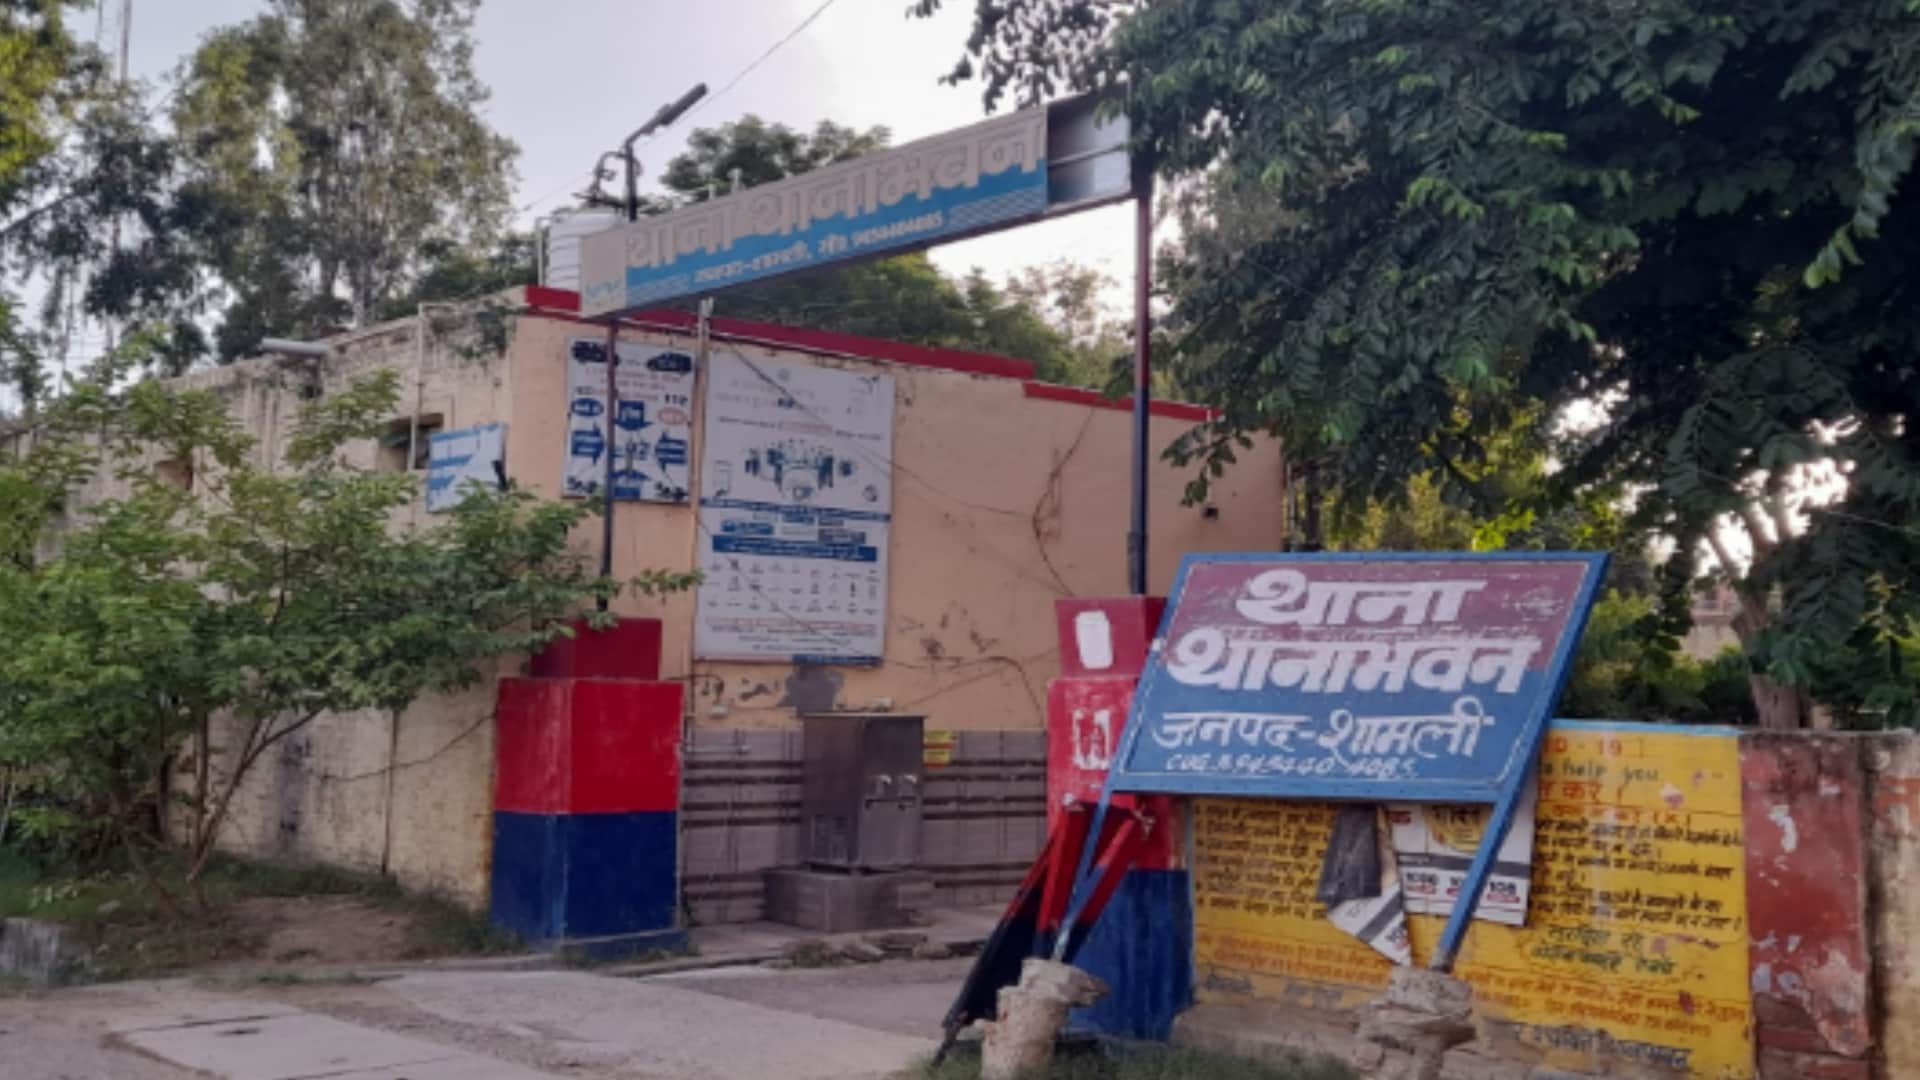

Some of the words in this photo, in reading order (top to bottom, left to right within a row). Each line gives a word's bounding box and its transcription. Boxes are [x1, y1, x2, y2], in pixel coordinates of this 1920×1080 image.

[626, 200, 736, 270] थाना
[745, 117, 1044, 238] थानाभवन
[1236, 568, 1488, 626] थाना
[1165, 626, 1543, 694] थानाभवन
[1152, 696, 1495, 759] जनपद-शामली
[1623, 765, 1659, 784] you
